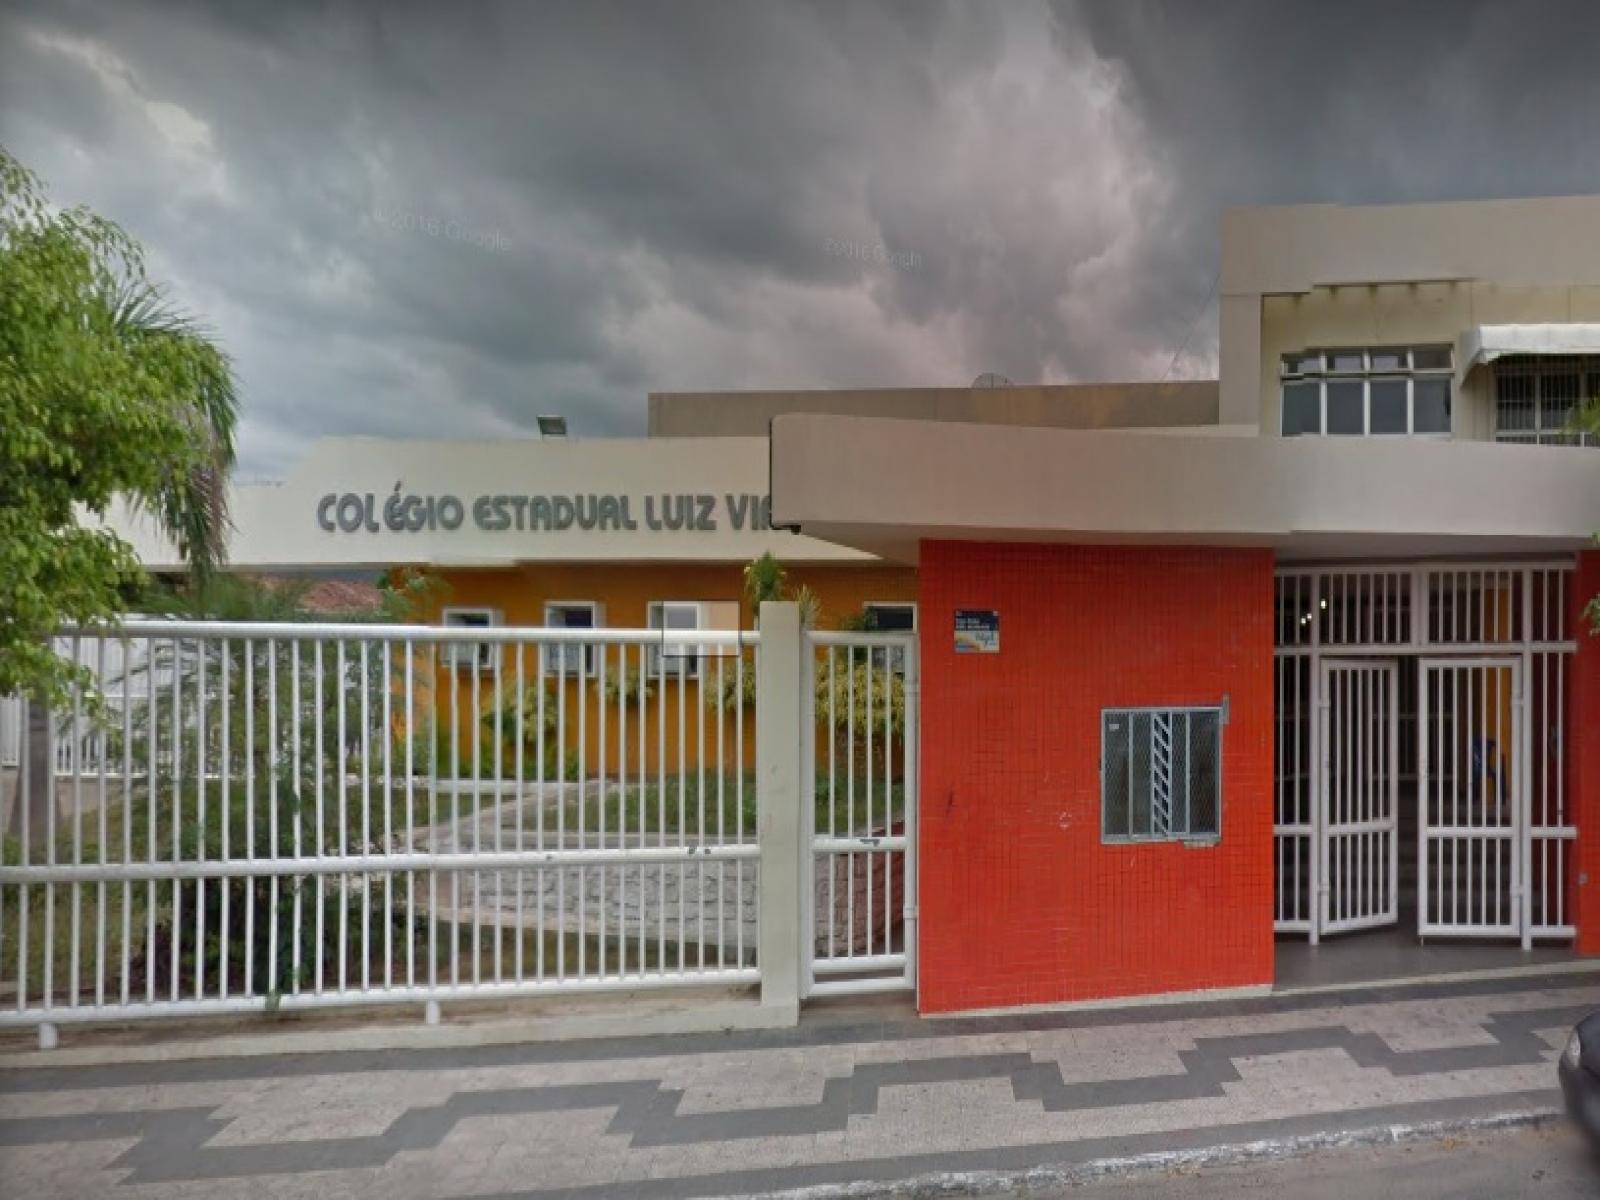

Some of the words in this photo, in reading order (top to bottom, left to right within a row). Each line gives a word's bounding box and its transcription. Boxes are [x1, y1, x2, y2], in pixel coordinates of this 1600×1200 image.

[317, 480, 464, 533] COLÉGIO
[473, 494, 638, 532] ESTADUAL
[645, 494, 717, 531] LUIZ
